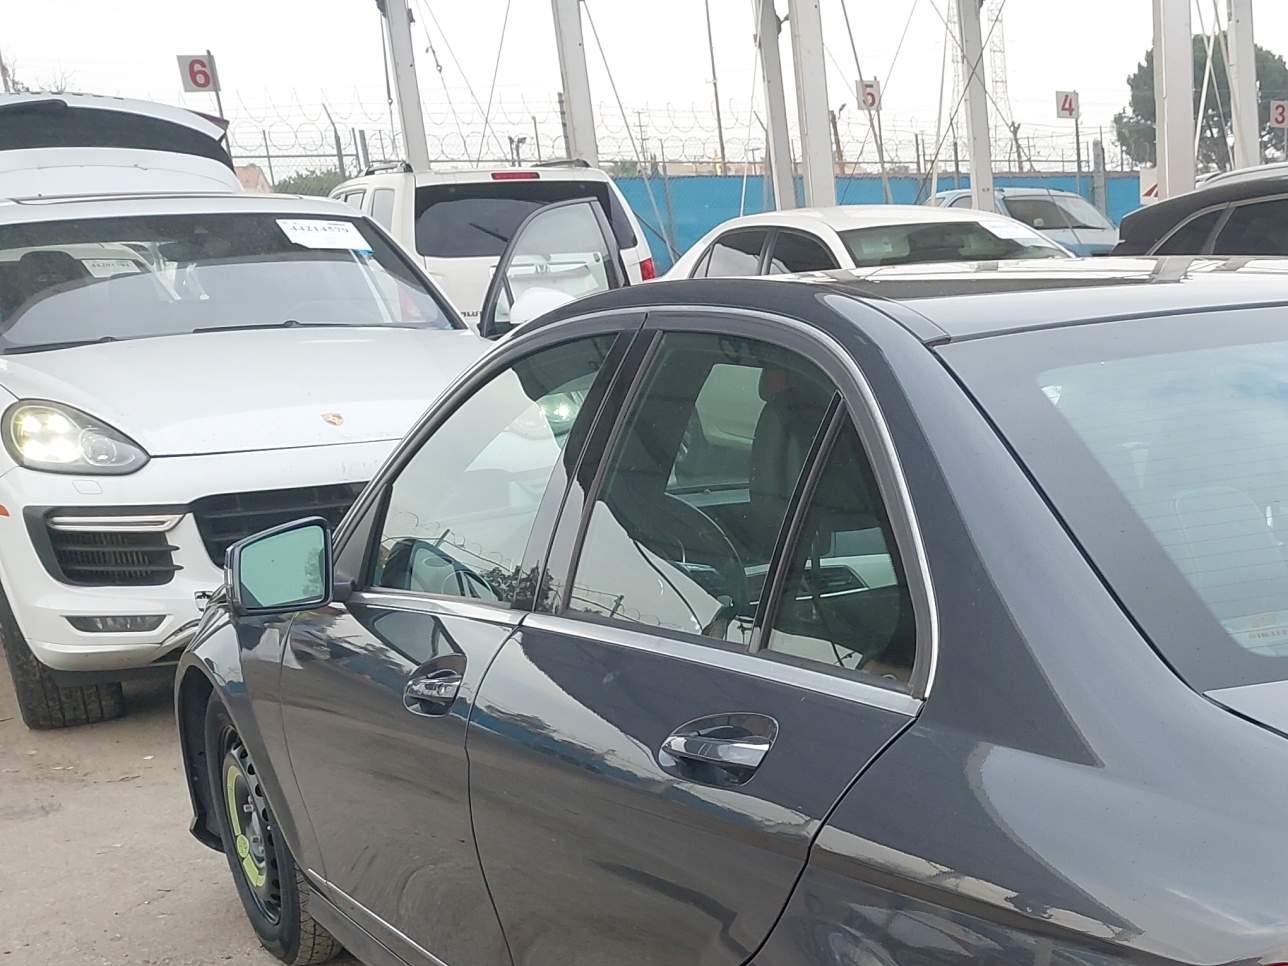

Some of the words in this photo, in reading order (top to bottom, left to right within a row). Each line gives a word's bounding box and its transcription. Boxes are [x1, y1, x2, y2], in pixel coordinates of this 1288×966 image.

[189, 59, 210, 88] 6
[863, 83, 876, 107] 5
[1061, 94, 1074, 116] 4
[1275, 104, 1286, 124] 3
